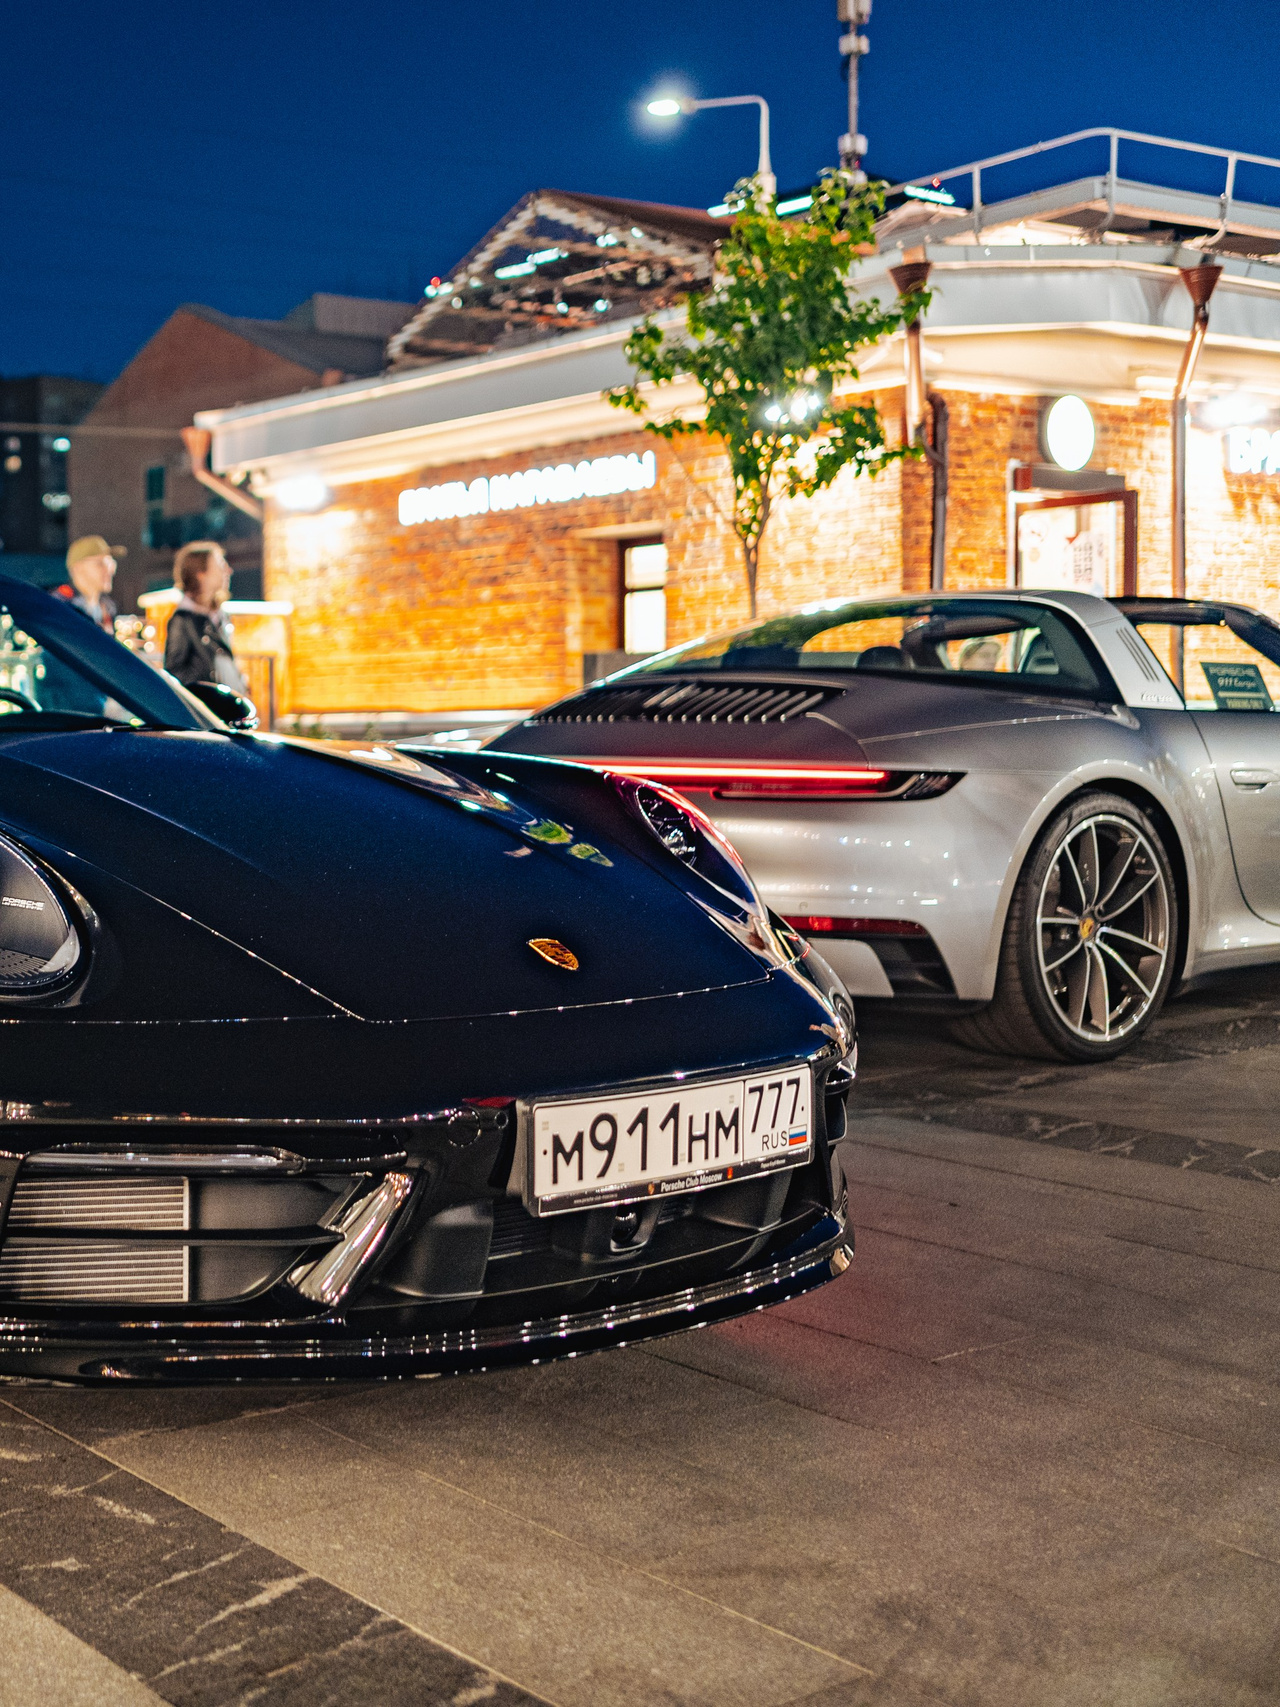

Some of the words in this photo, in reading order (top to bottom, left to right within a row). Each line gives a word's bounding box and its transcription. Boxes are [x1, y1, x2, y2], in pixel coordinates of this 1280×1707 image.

[1217, 677, 1233, 687] 911
[748, 1077, 801, 1134] 777
[762, 1130, 788, 1151] RUS
[661, 1178, 685, 1193] Porsche
[686, 1175, 699, 1187] Club
[699, 1172, 723, 1184] Moscow
